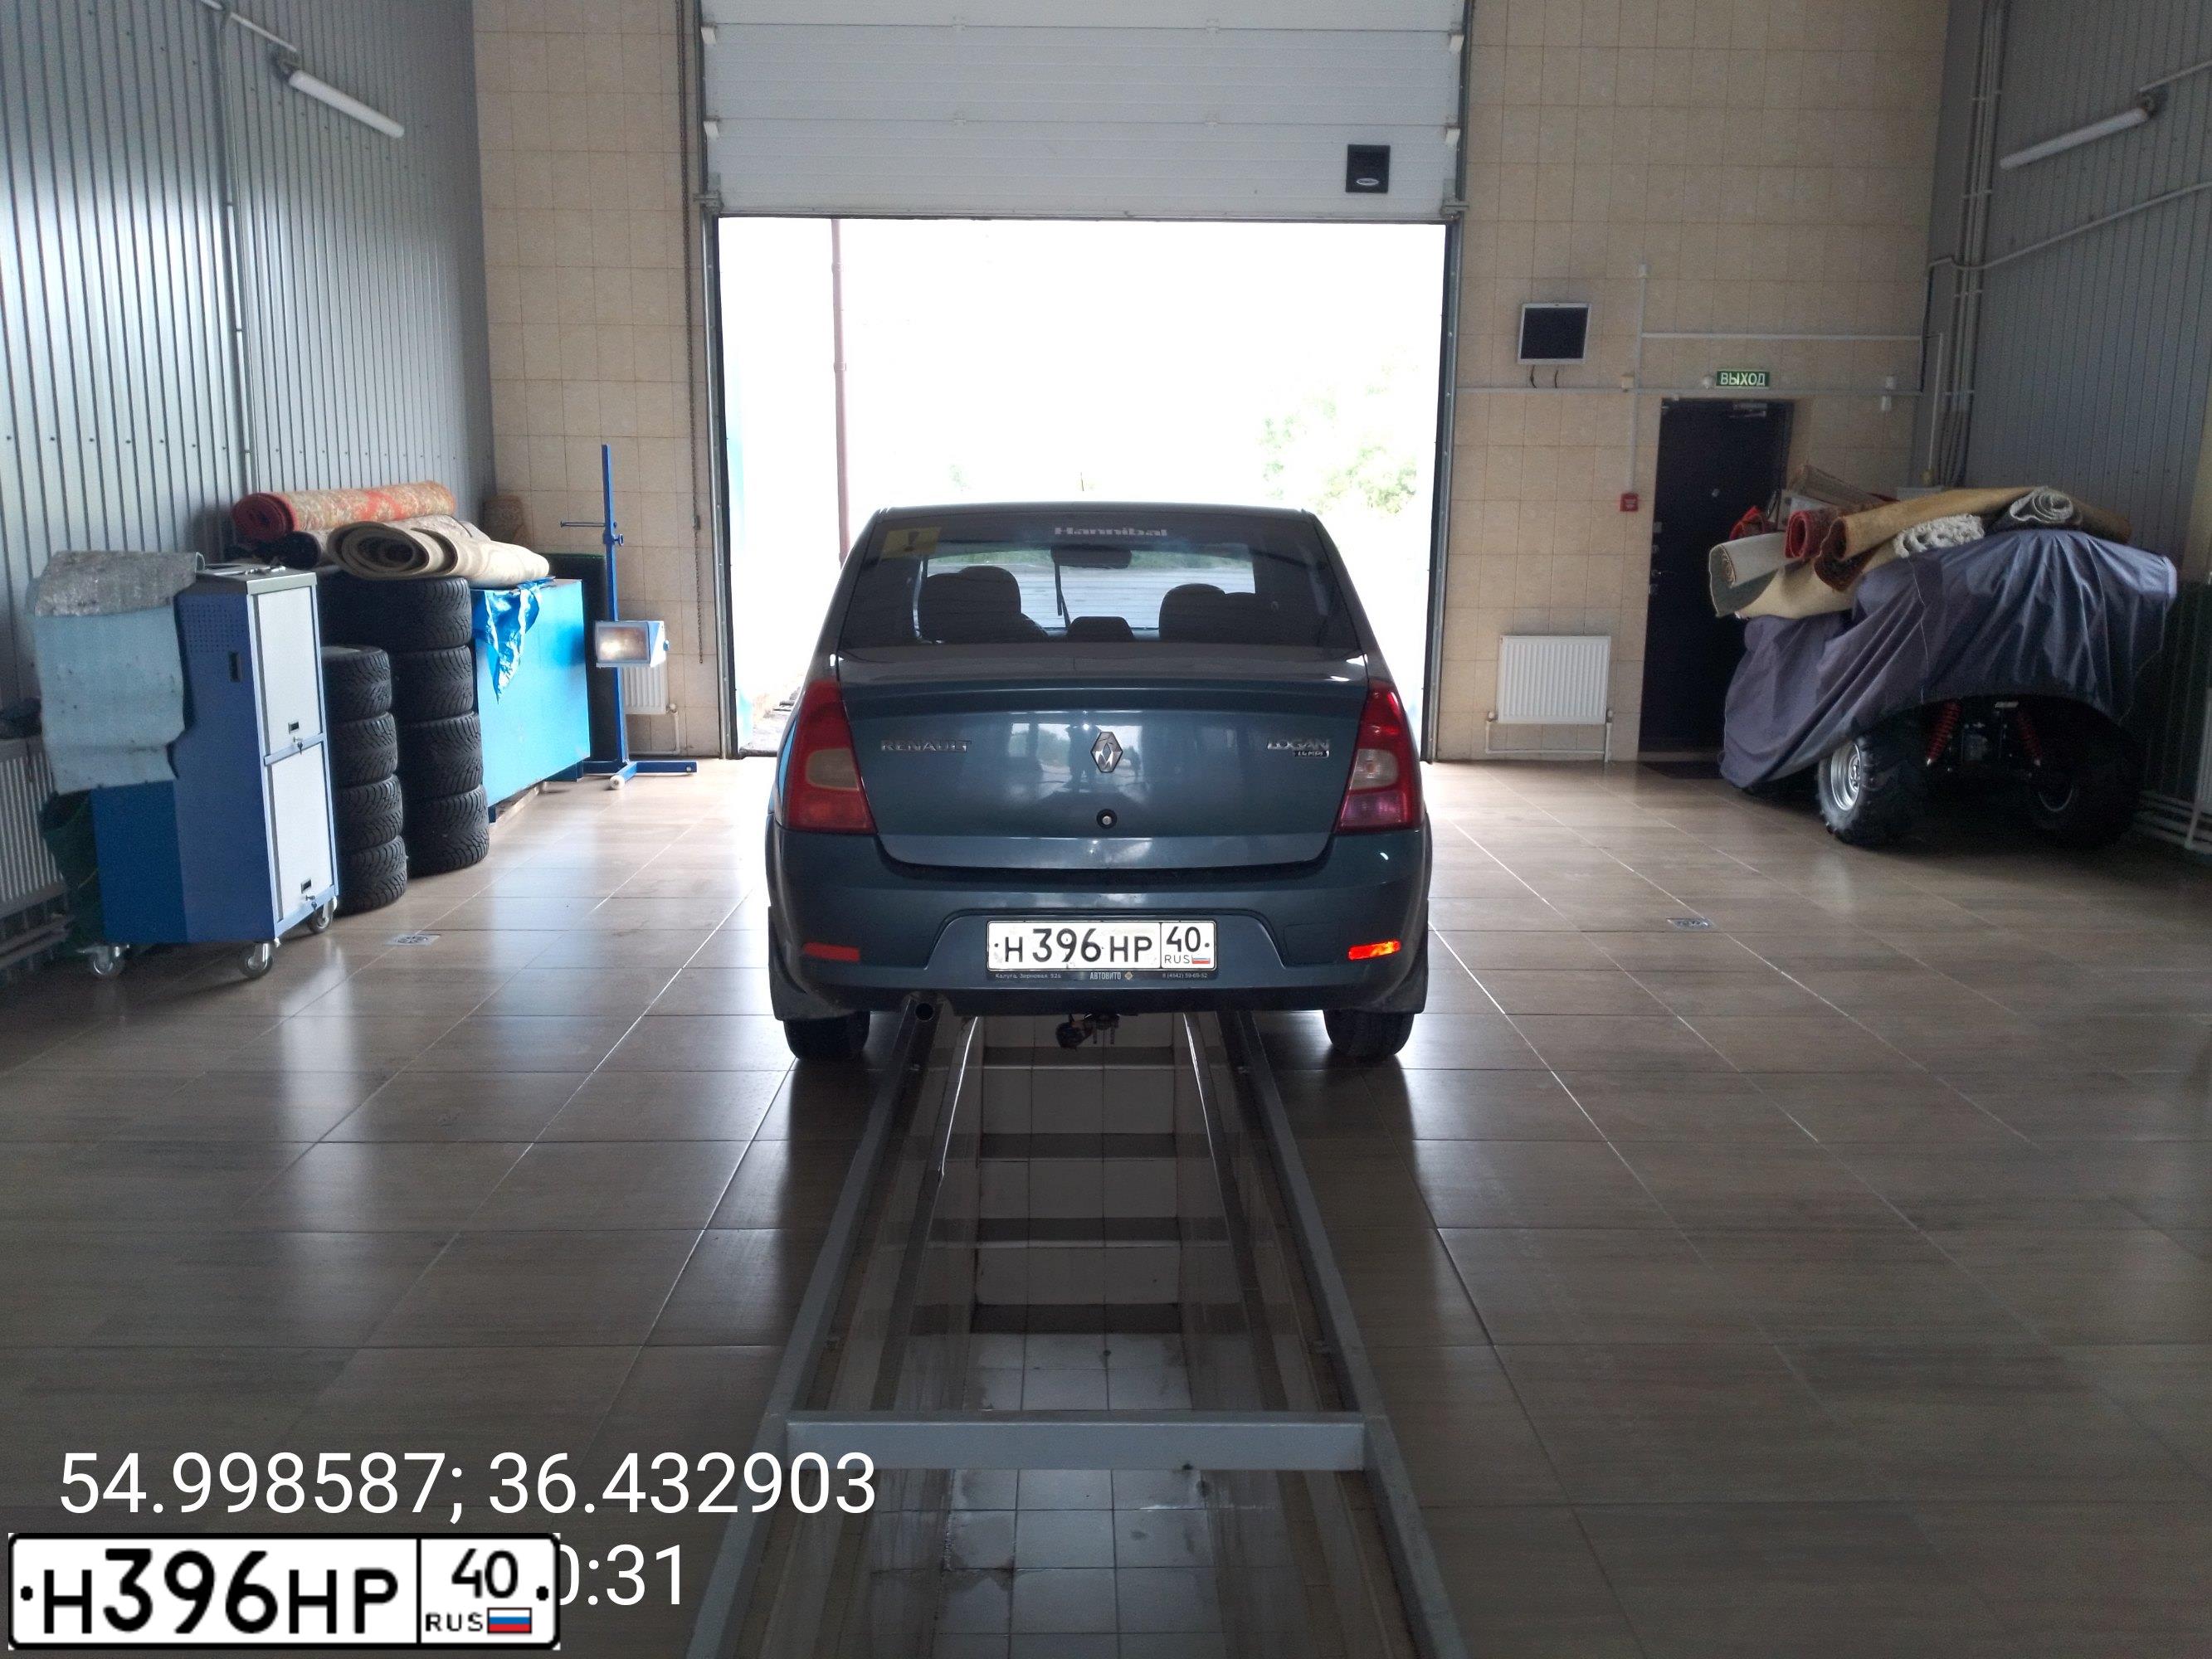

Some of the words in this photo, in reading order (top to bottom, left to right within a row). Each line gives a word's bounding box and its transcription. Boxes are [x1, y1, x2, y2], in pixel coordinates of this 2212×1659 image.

[1720, 372, 1766, 387] ВЫХОД
[881, 739, 972, 752] RENAULT
[1267, 738, 1330, 750] LOGAN
[1166, 926, 1201, 952] 40
[1164, 954, 1190, 964] RUS
[1089, 971, 1122, 980] АВТОВИТО
